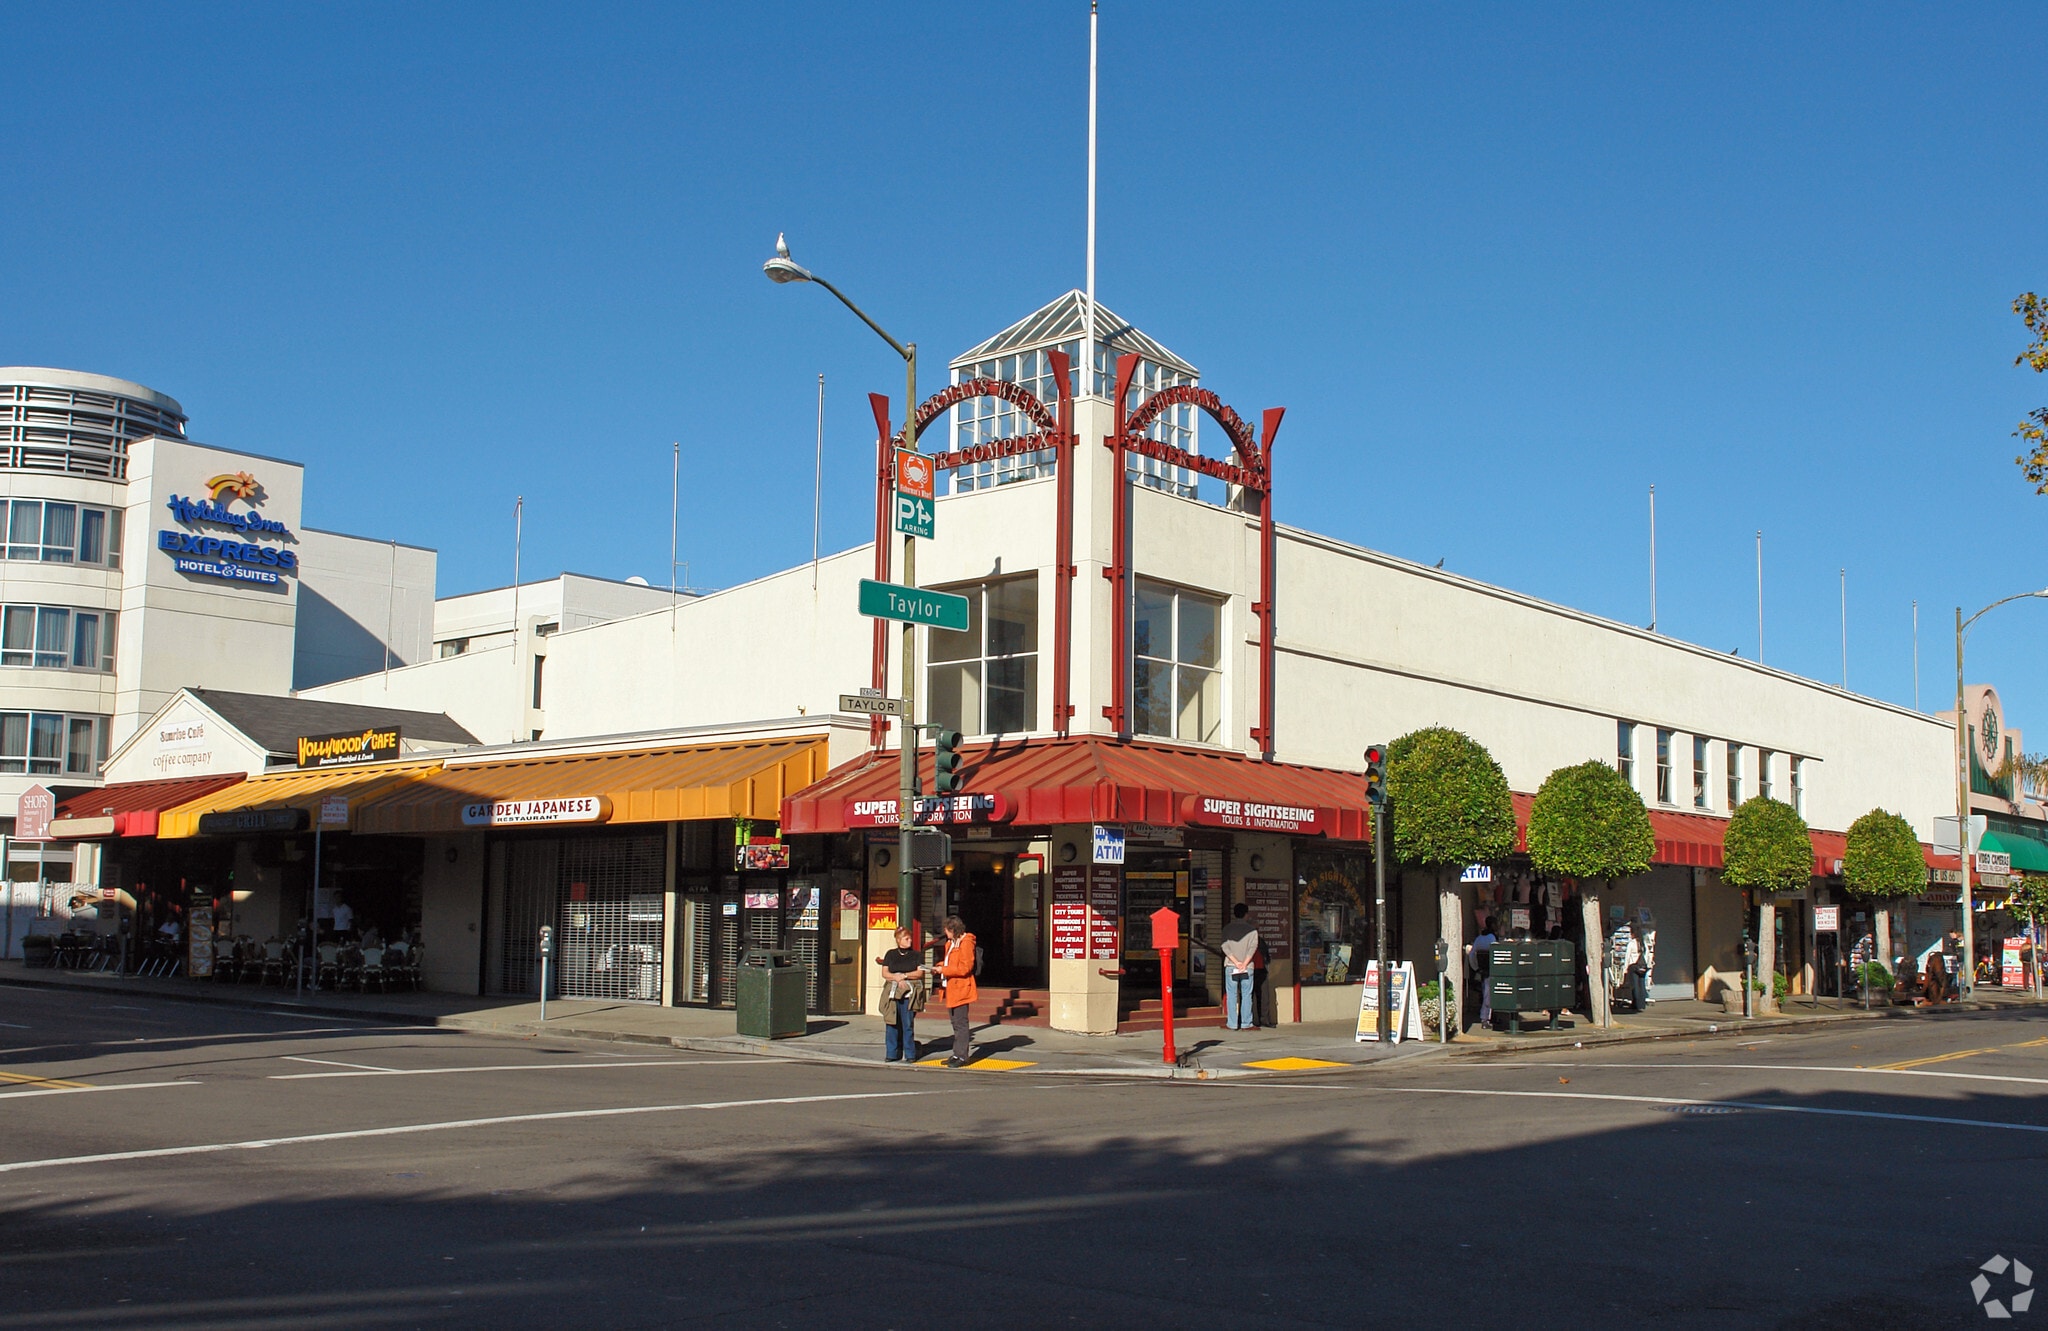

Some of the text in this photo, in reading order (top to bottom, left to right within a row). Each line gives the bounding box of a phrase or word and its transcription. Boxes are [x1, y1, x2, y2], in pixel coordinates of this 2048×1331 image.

[998, 380, 1050, 428] WHARF
[960, 429, 1050, 466] COMPLEX
[167, 494, 289, 534] Holiday Inn
[158, 530, 298, 569] EXPRESS
[180, 560, 276, 582] HOTEL & SUITES
[888, 592, 942, 619] Taylor
[847, 699, 895, 712] TAYLOR
[160, 723, 204, 743] Sunrise Café
[298, 736, 362, 766] HOLLYWOOD
[371, 732, 397, 755] CAFE
[153, 751, 213, 772] coffee company
[23, 795, 48, 809] SHOPS
[468, 799, 593, 818] GARDEN JAPANESE
[853, 793, 995, 816] SUPER GHTSEEING
[1203, 798, 1315, 823] SUPER SIGHTSEEING
[236, 813, 267, 829] GRILL
[496, 814, 560, 823] RESTAURANT
[873, 813, 900, 825] TOURS
[1222, 815, 1299, 831] TOURS & INFORMATION
[1095, 845, 1123, 860] ATM
[1979, 851, 2009, 867] VIDEO CAMERAS
[1460, 867, 1489, 879] ATM
[1916, 892, 1959, 902] Canon
